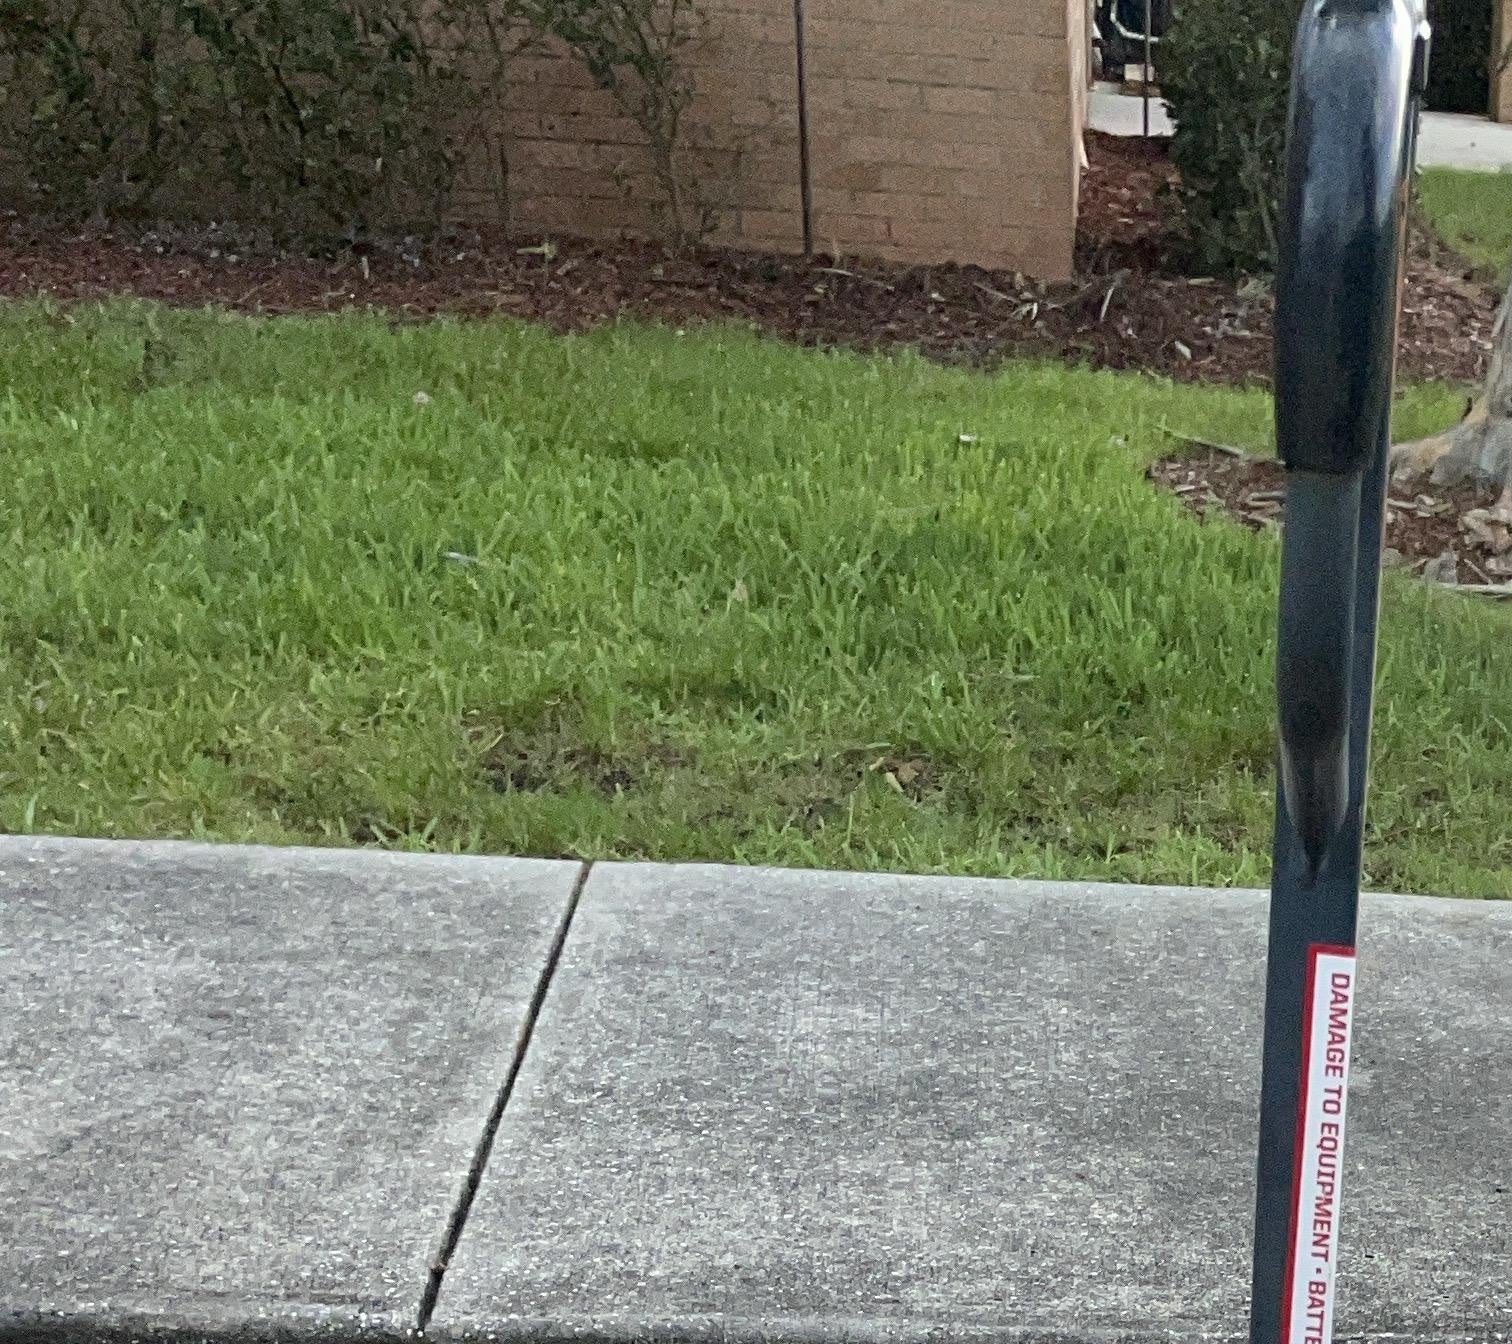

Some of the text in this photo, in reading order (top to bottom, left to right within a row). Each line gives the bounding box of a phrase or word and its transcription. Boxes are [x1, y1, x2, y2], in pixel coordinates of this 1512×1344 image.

[1324, 972, 1351, 1079] DAMAGE
[1322, 1084, 1343, 1115] TO
[1311, 1121, 1339, 1263] EQUIPMENT
